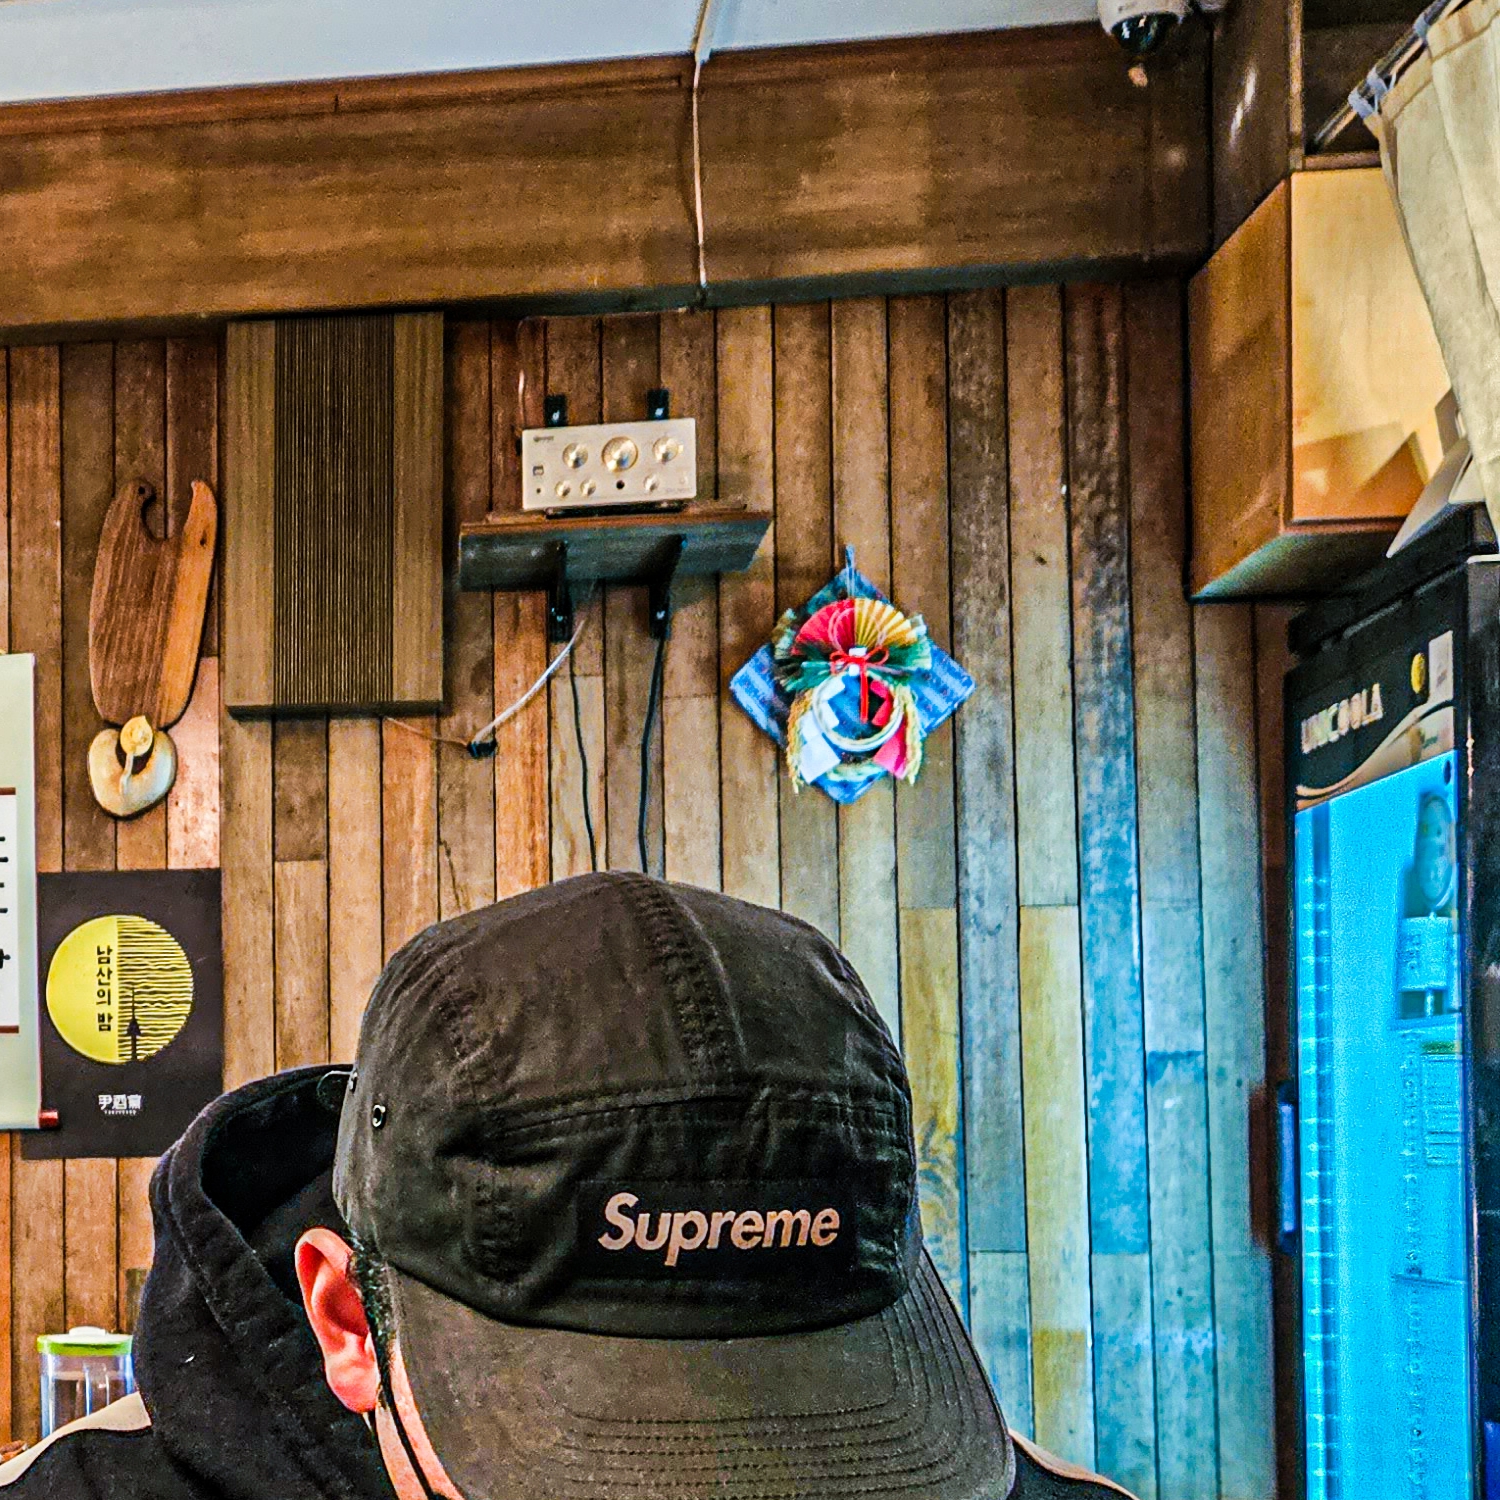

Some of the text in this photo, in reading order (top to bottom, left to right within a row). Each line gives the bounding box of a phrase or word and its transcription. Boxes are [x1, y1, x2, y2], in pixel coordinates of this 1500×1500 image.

[96, 945, 113, 1032] 남산의 밤
[598, 1192, 840, 1267] Supreme
